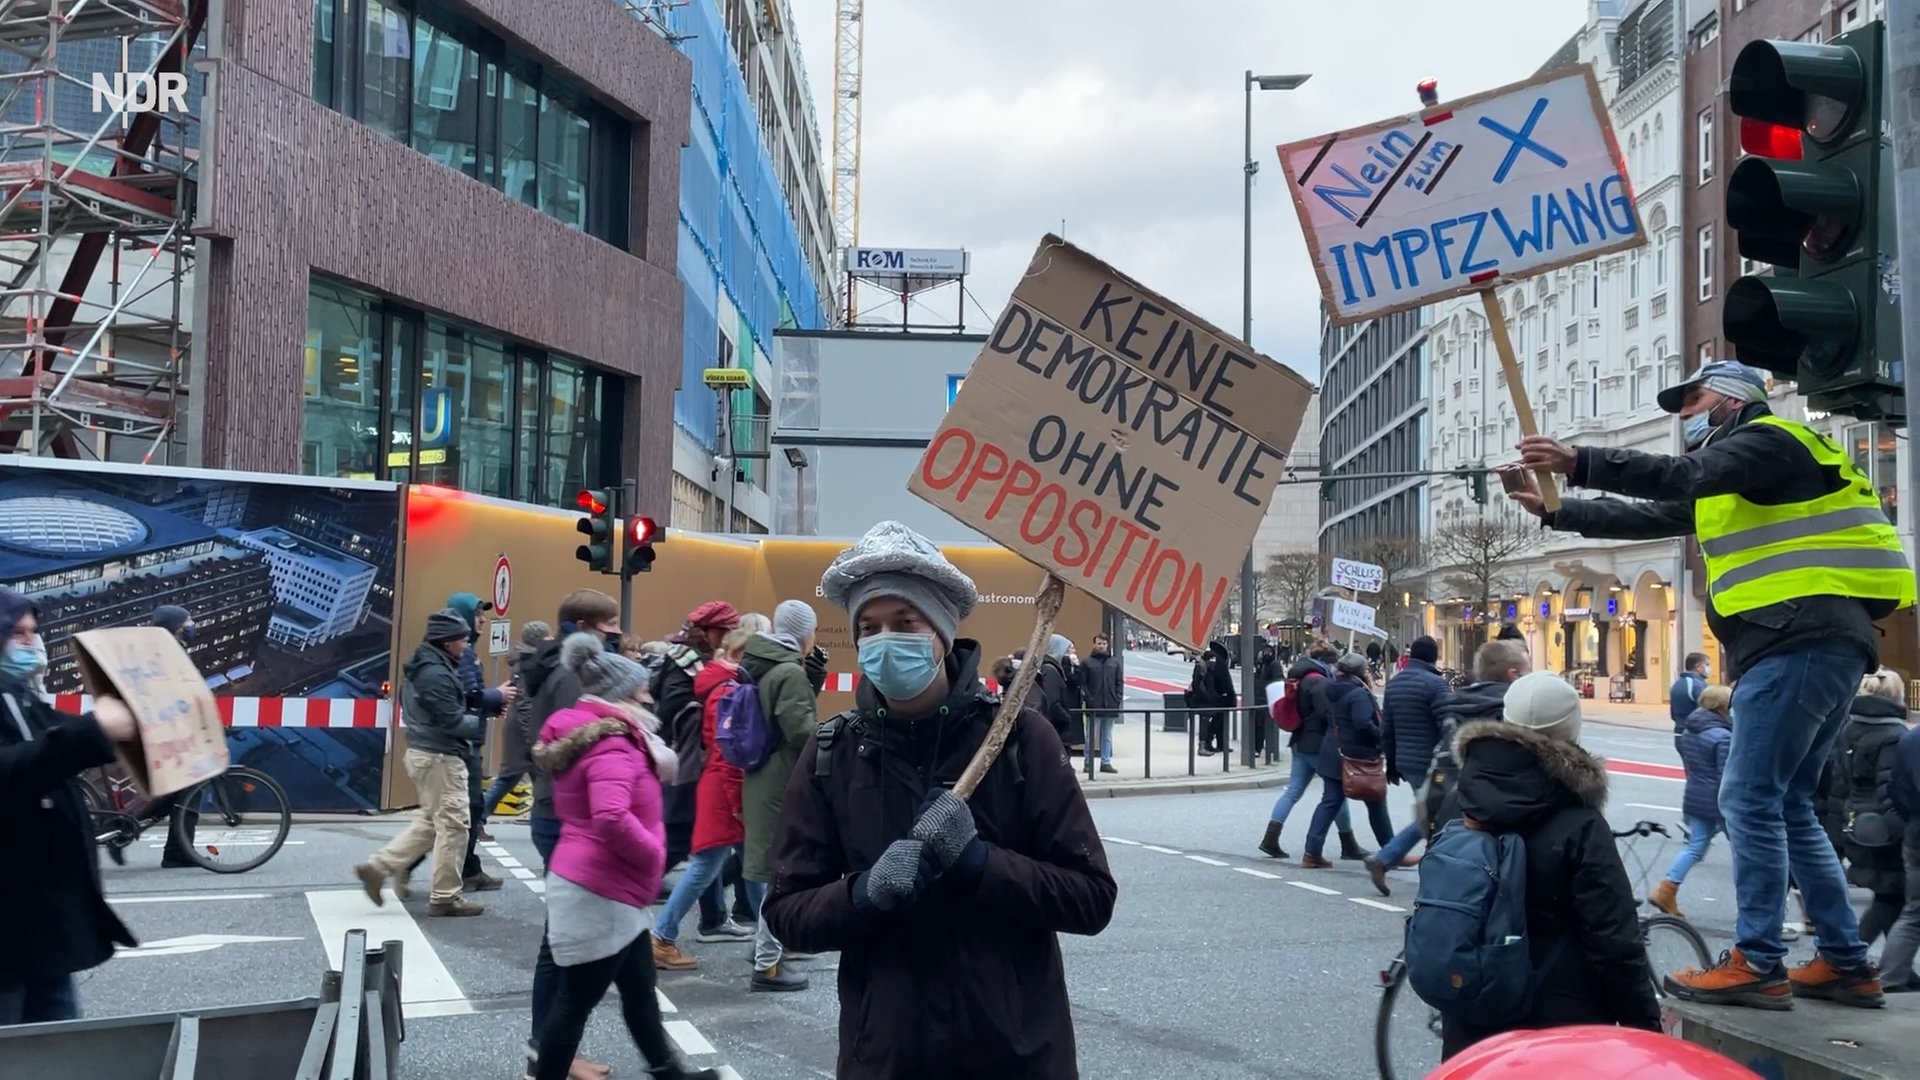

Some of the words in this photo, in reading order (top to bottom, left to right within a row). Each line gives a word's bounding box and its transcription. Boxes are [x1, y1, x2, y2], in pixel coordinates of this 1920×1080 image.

[1312, 129, 1415, 222] Nein
[1404, 139, 1453, 190] zum
[1329, 174, 1638, 305] IMPFZWANG
[990, 304, 1287, 506] DEMOKRATIE
[1080, 283, 1257, 417] KEINE
[1028, 415, 1180, 532] OHNE
[922, 428, 1228, 646] OPPOSITION
[977, 590, 1036, 604] astronom
